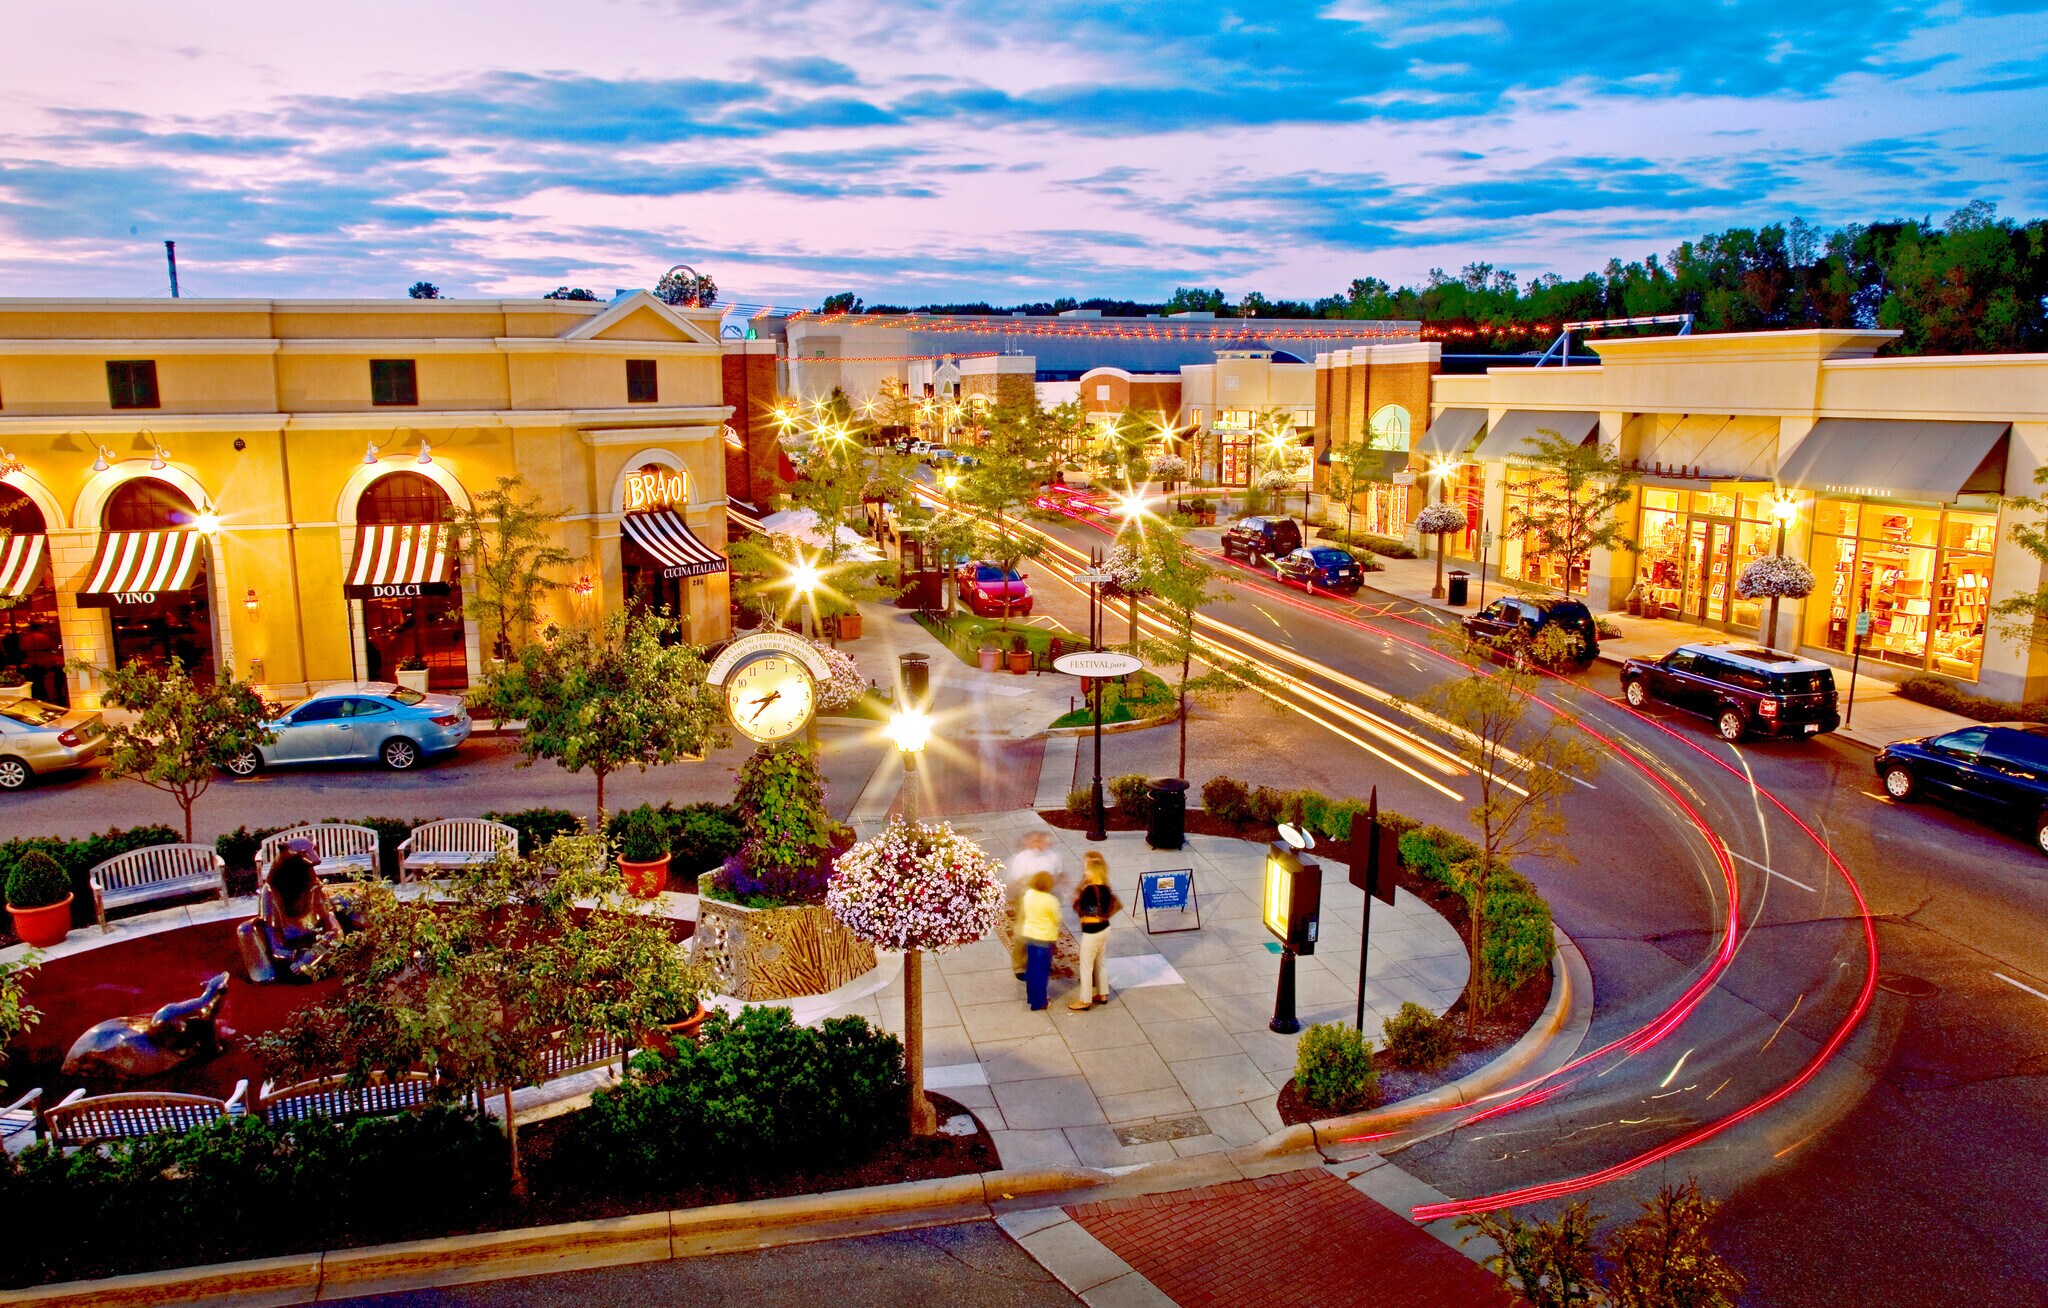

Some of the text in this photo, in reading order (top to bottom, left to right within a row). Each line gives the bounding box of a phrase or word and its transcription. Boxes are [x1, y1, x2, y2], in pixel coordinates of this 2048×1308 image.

[628, 470, 688, 507] BRAVO!
[664, 561, 726, 578] CUCINA ITALIANA
[372, 584, 422, 597] DOLCI
[113, 592, 156, 604] VINO
[710, 666, 718, 674] TO
[716, 638, 754, 667] EVERYTHING
[793, 640, 816, 658] SEASON
[816, 656, 826, 670] AND
[732, 649, 748, 661] TIME
[782, 644, 810, 662] PURPOSE
[765, 661, 775, 670] 12
[784, 664, 788, 672] 1
[1070, 660, 1127, 670] FESTIVAL park
[749, 668, 756, 676] 11
[738, 678, 746, 688] 10
[797, 674, 803, 683] 2
[732, 696, 738, 704] 9
[804, 692, 810, 700] 3
[798, 709, 804, 718] 4
[753, 724, 758, 732] 7
[770, 726, 776, 735] 6
[786, 722, 792, 730] 5
